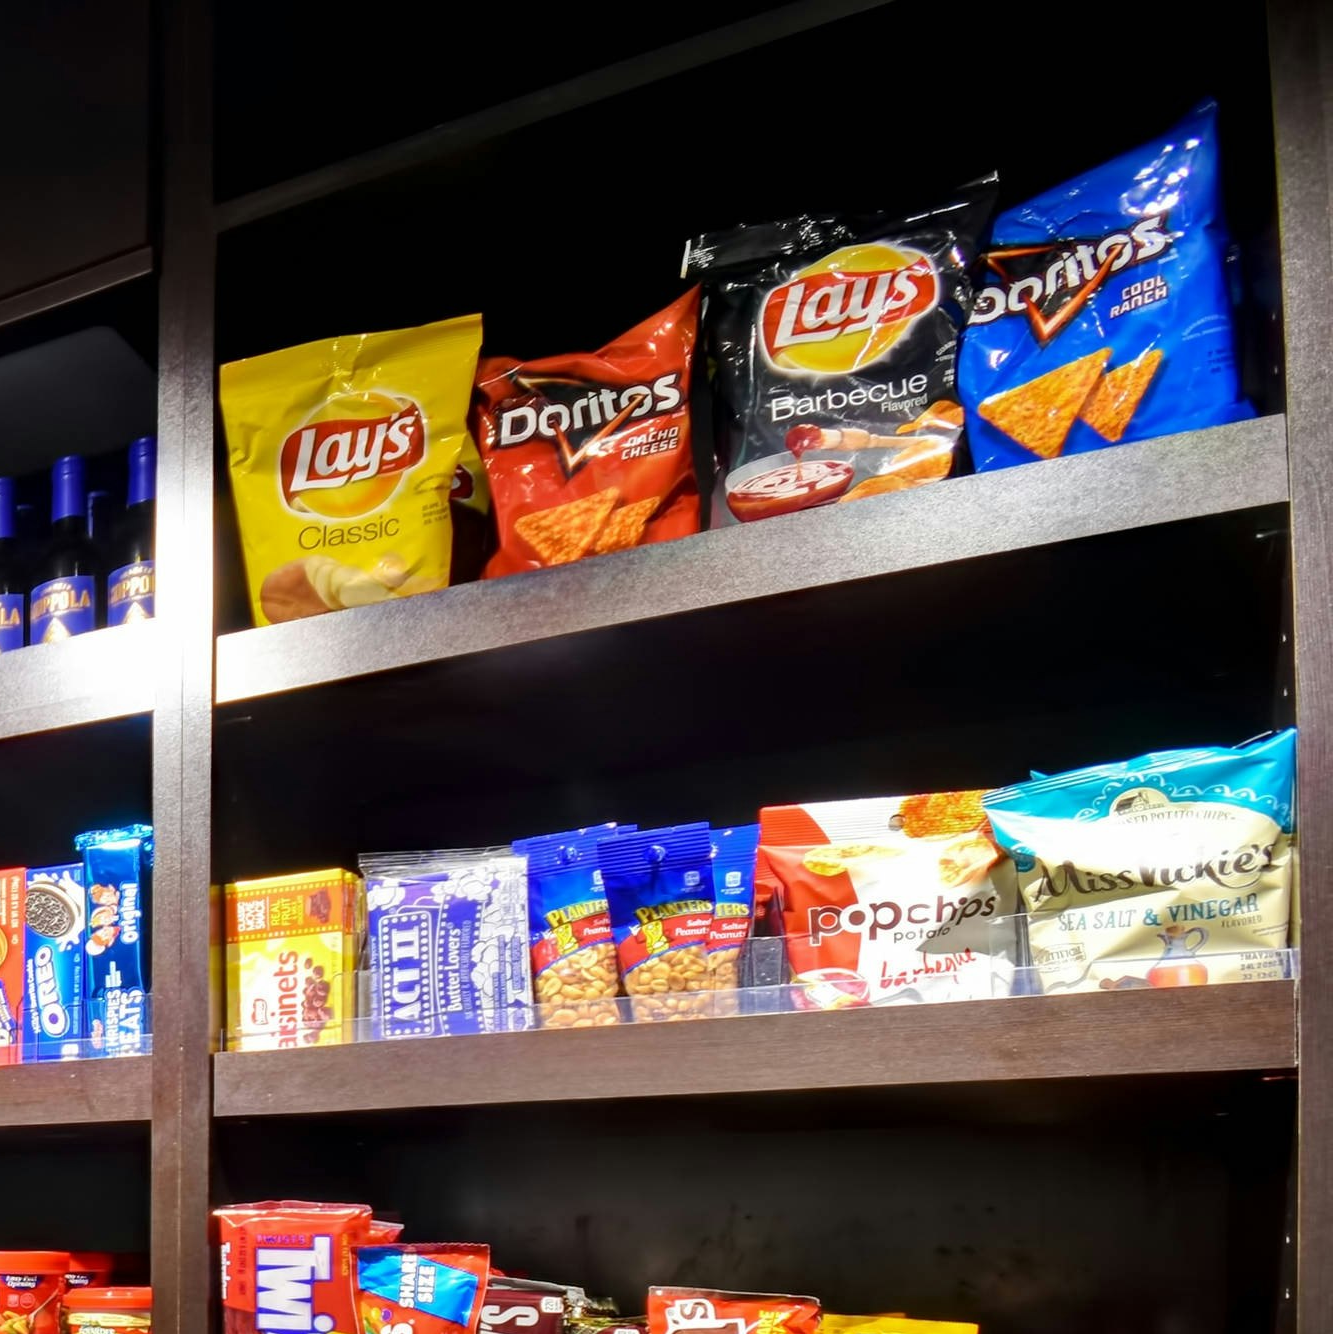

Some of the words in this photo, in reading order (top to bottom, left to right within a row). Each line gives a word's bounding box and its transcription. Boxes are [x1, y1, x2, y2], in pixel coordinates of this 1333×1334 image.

[773, 264, 925, 348] Lay's
[1109, 286, 1169, 321] RANCH
[1121, 274, 1167, 300] COOL
[498, 373, 681, 448] Doritos
[771, 373, 928, 423] Barbecue
[880, 393, 929, 414] Flavored
[290, 413, 419, 493] Lay's
[621, 438, 679, 461] CHEESE
[298, 515, 400, 550] Classic
[1033, 859, 1134, 902] Miss
[120, 882, 141, 944] original
[636, 897, 713, 924] PLANTERS
[685, 918, 711, 930] Salted
[720, 921, 748, 933] Salted
[808, 893, 997, 946] popchips
[1058, 911, 1088, 932] SEA
[1094, 908, 1136, 930] SALT
[1143, 907, 1163, 926] &
[1168, 892, 1260, 920] VINEGAR
[1221, 914, 1262, 928] FLAVORED
[447, 928, 461, 967] Lovers
[709, 929, 749, 942] Peanuts
[892, 925, 952, 944] potato
[879, 947, 977, 990] barbeque
[35, 946, 69, 1036] OREO
[392, 962, 421, 1022] ACT
[447, 967, 464, 1014] Butter
[398, 1248, 418, 1309] SHARE
[417, 1264, 436, 1304] SIZE
